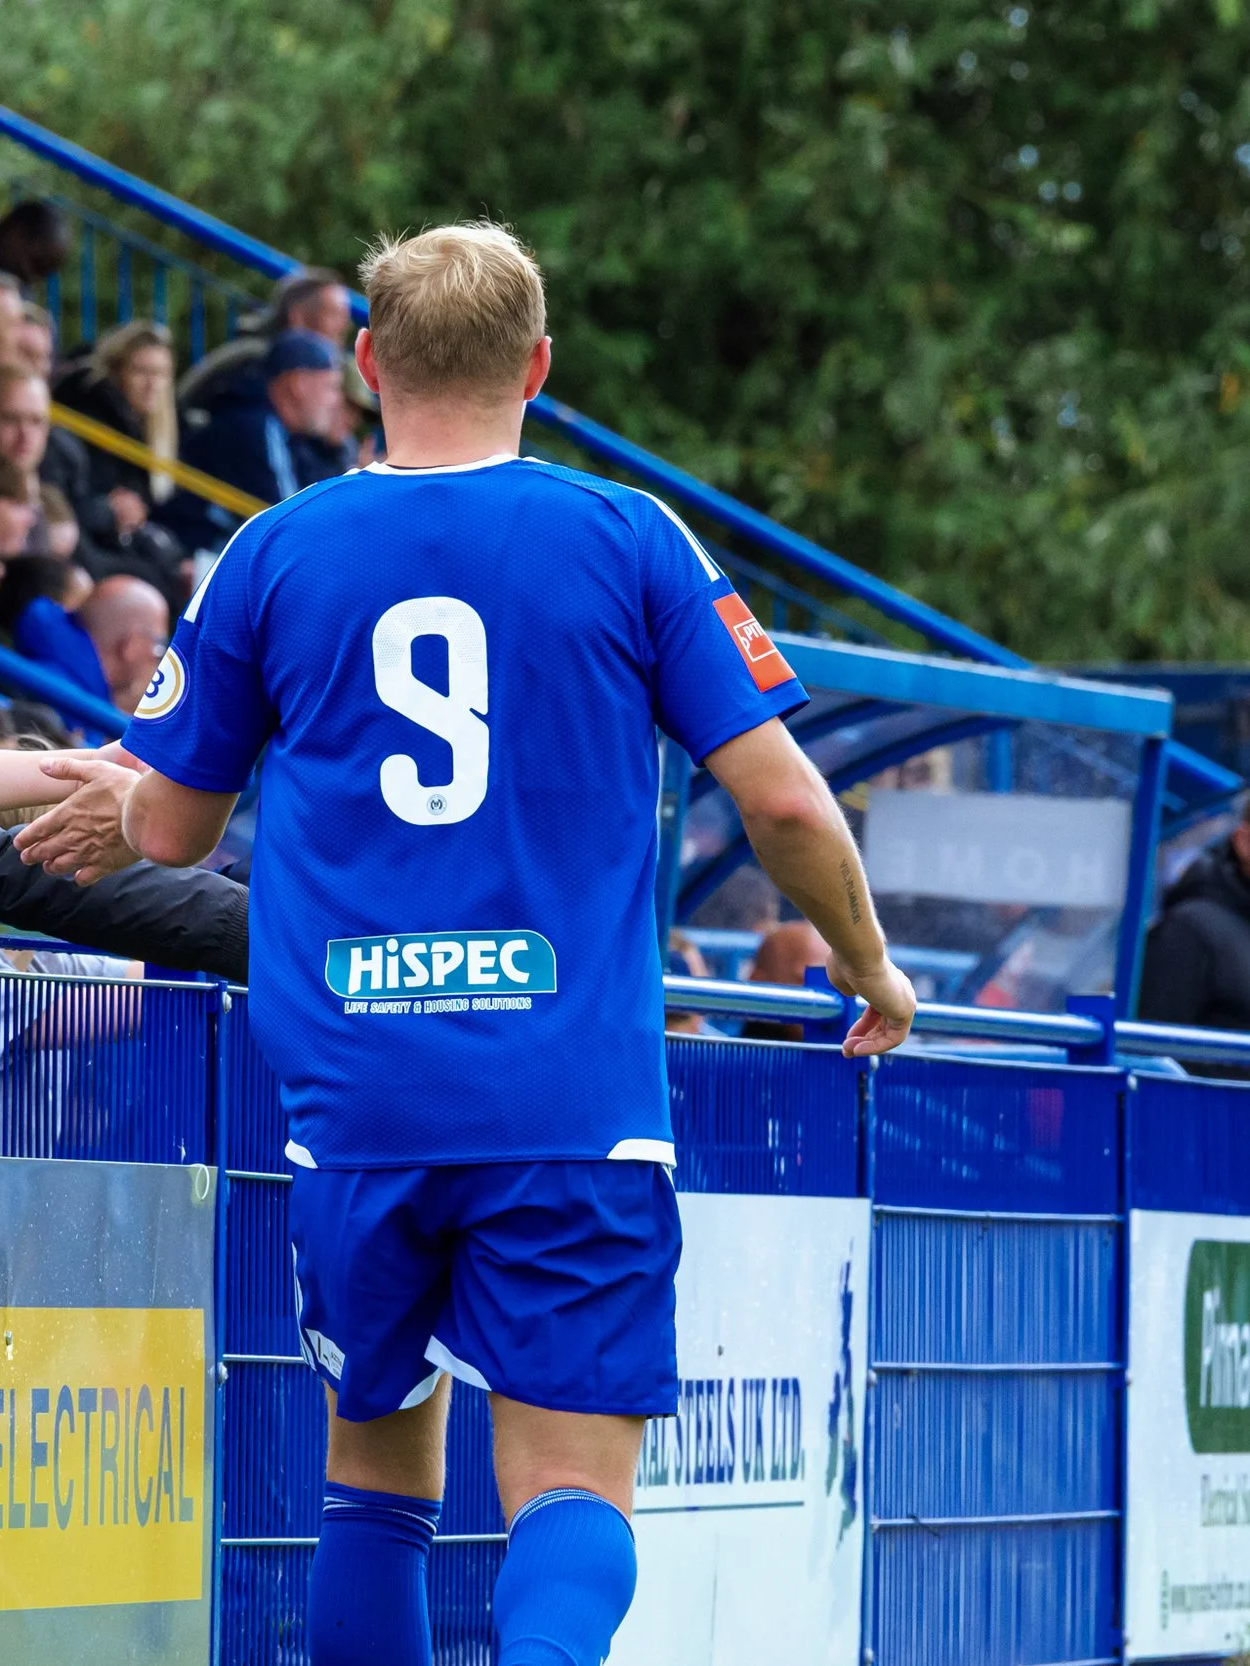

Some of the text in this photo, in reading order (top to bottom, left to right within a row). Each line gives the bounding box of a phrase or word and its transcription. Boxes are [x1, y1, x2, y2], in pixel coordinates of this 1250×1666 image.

[372, 596, 490, 826] 9
[344, 997, 532, 1014] LIFE SAFETY & HOUSING SOLUTIONS
[347, 938, 529, 995] HiSPEC
[674, 1377, 736, 1486] STEELS
[742, 1378, 766, 1483] UK
[771, 1377, 805, 1482] LTD.
